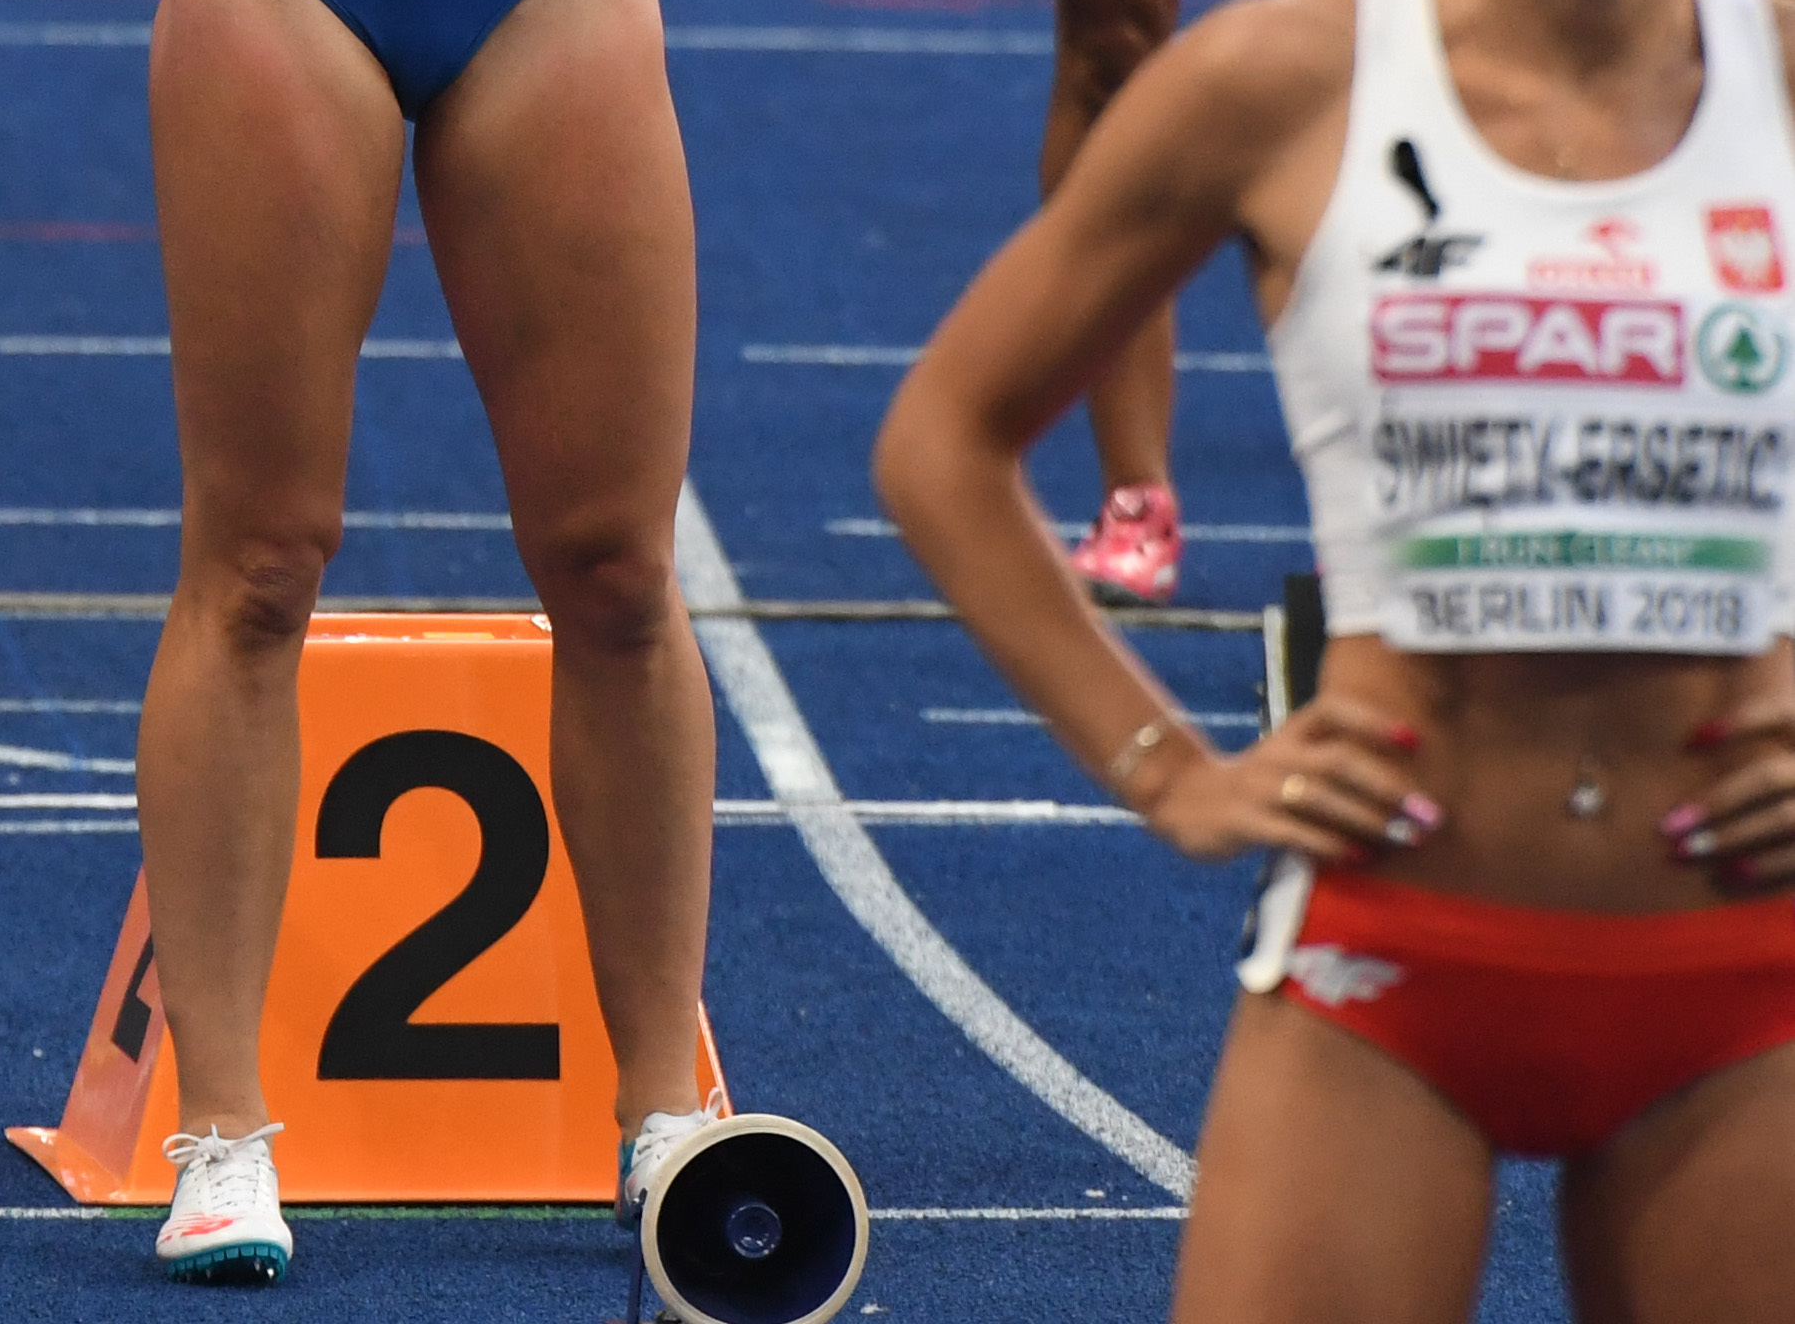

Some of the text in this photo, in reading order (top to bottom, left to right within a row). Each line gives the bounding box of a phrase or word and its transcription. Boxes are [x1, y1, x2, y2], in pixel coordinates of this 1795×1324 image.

[1378, 303, 1677, 376] SPAR
[1412, 582, 1745, 637] BERLIN 2018
[315, 729, 560, 1080] 2
